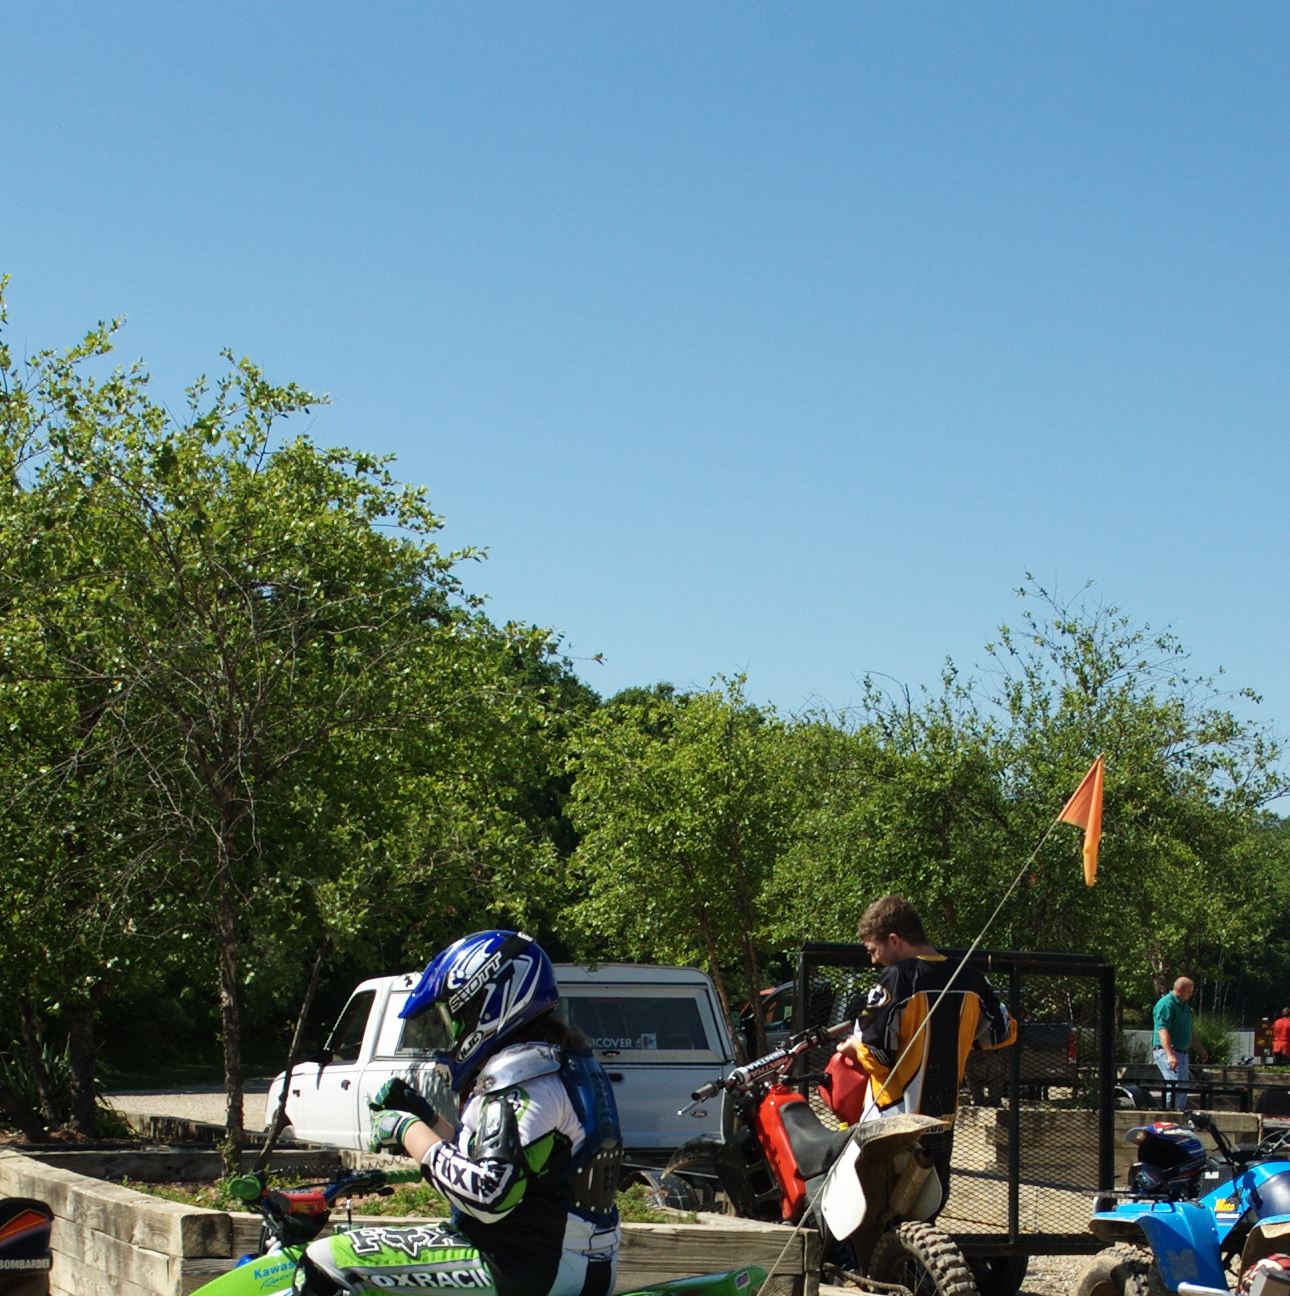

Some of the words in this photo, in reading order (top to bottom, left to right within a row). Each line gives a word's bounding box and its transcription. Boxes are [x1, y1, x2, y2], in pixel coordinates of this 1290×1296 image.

[449, 950, 502, 1014] SCOTT
[459, 1034, 481, 1059] HJC
[253, 1260, 297, 1280] Kawas
[363, 1267, 493, 1288] OXRACIN
